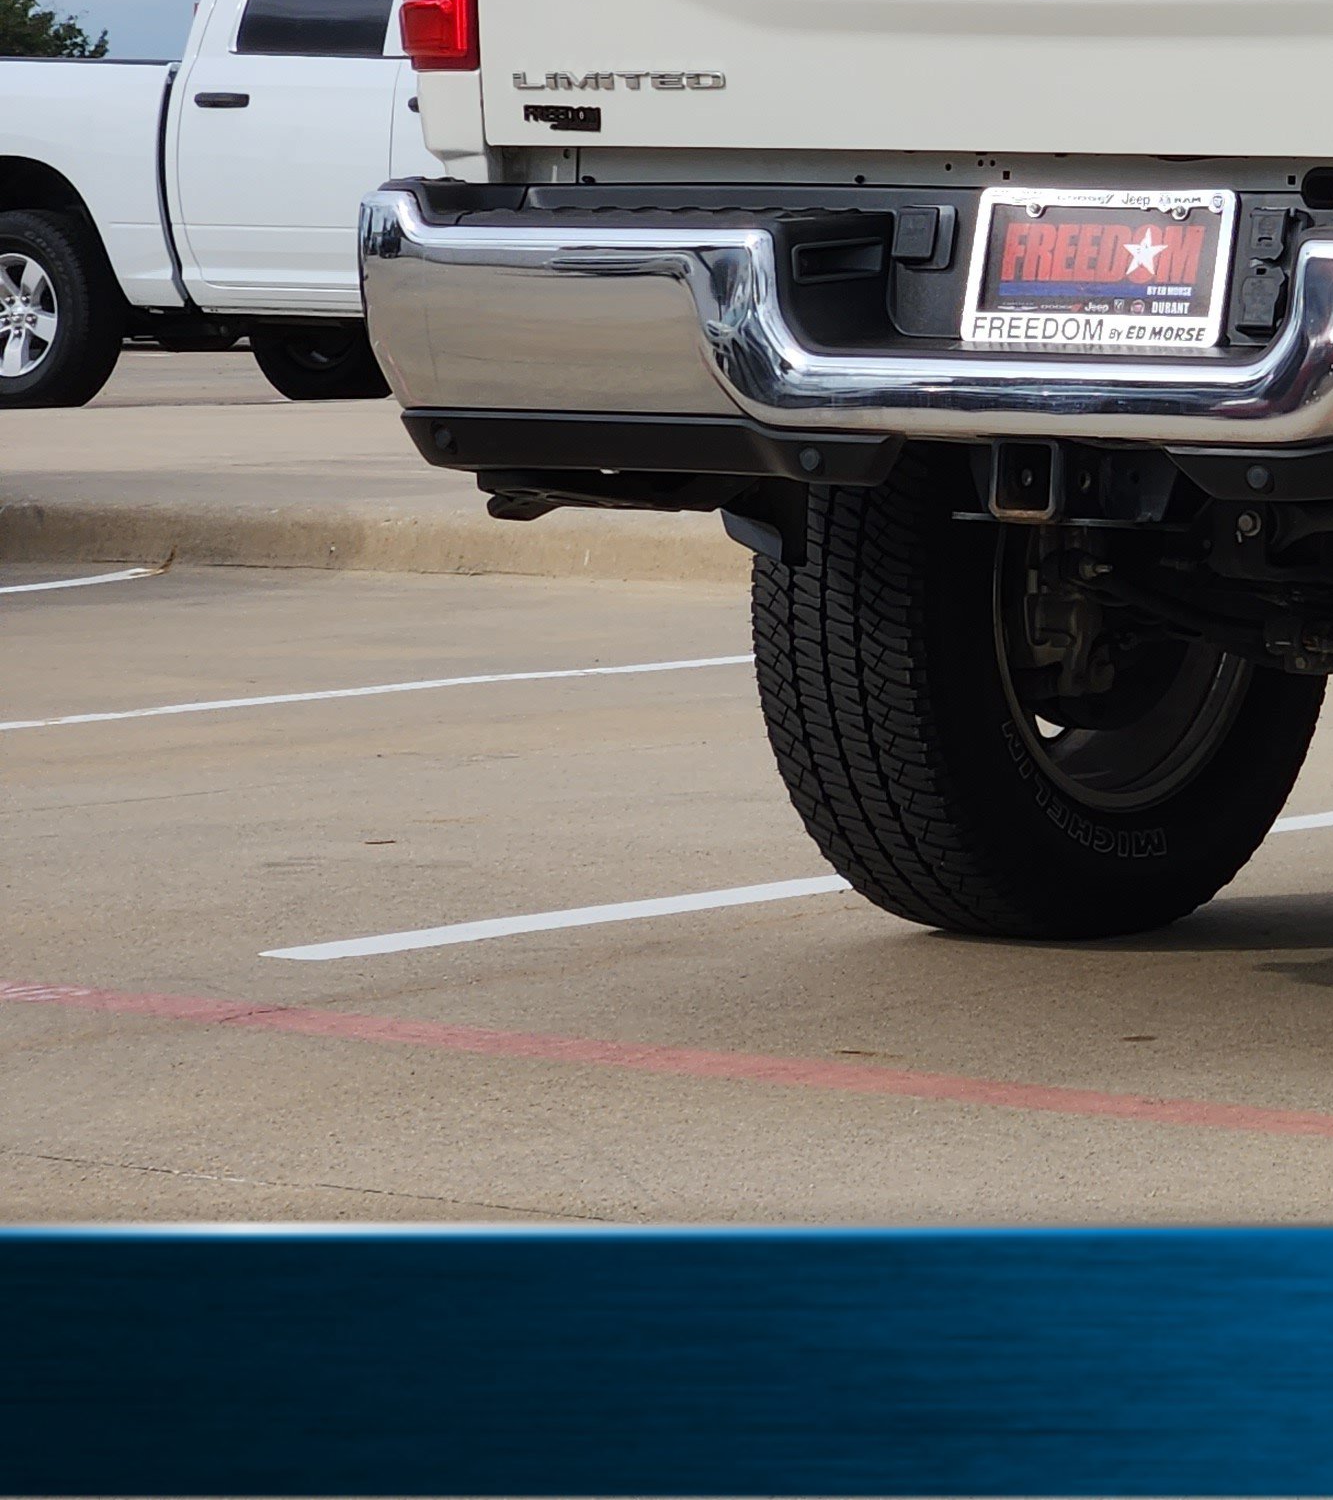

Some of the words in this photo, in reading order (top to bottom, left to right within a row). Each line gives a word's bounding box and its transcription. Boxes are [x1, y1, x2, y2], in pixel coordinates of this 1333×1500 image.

[512, 70, 726, 90] LIMITED
[999, 222, 1205, 285] FREEDOM
[1084, 301, 1109, 314] Jeep
[1151, 301, 1191, 314] DURANT
[972, 316, 1104, 342] FREEDOM
[1108, 328, 1123, 342] BY
[1125, 325, 1145, 341] ED
[1148, 326, 1206, 343] MORSE
[1000, 718, 1168, 858] MICHELIN
